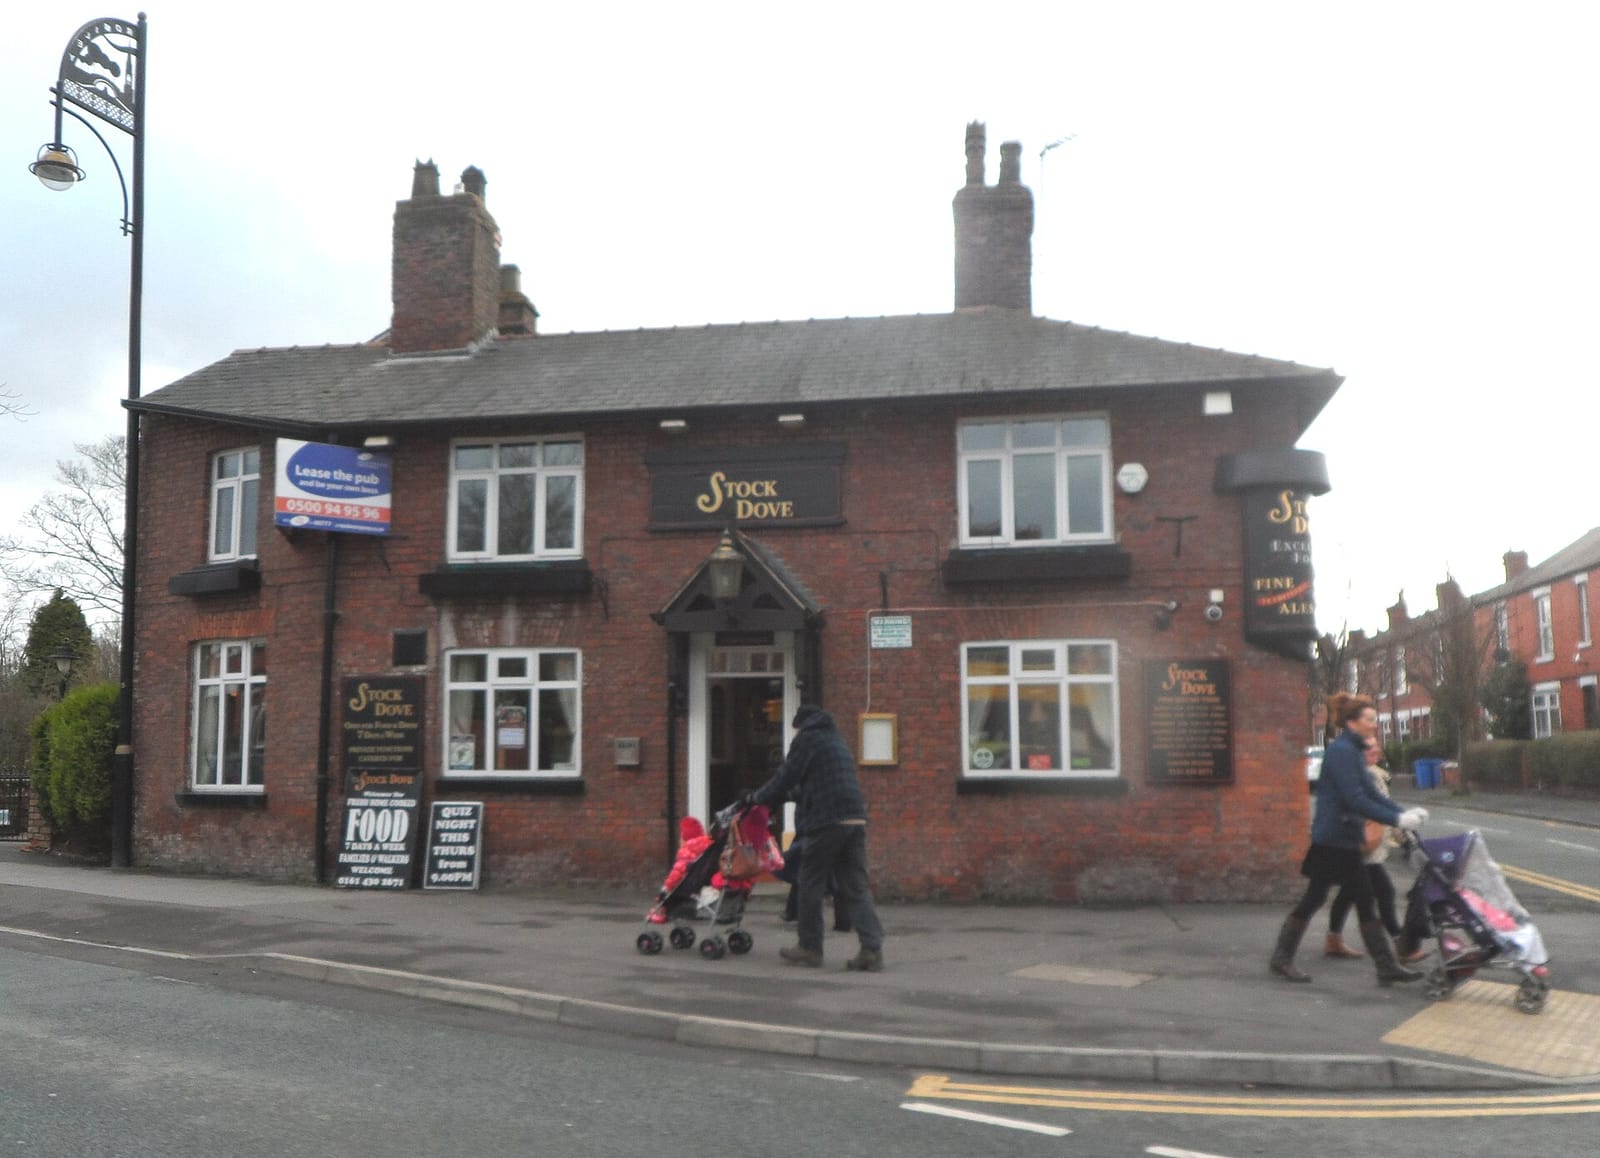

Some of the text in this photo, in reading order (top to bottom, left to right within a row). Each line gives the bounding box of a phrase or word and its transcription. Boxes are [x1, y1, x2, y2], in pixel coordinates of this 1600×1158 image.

[295, 464, 379, 485] Lease the pub
[697, 471, 778, 513] STOCK
[286, 499, 380, 520] 0500 94 95 96
[737, 499, 794, 519] DOVE
[1256, 577, 1294, 590] FINE
[1162, 663, 1207, 691] STOCK
[1181, 681, 1216, 695] DOVE
[349, 683, 403, 712] STOCK
[375, 702, 414, 716] DOVE
[354, 772, 413, 791] STOCK DOVE
[441, 807, 473, 818] QUIZ
[345, 808, 410, 842] FOOD
[436, 819, 476, 830] NIGHT
[440, 832, 470, 843] THIS
[345, 842, 351, 850] 7
[351, 842, 372, 850] DAYS
[382, 843, 406, 851] WEEK
[433, 846, 476, 856] THURS
[339, 853, 370, 863] FAMILIES
[438, 859, 467, 869] from
[351, 866, 393, 875] WELCOME
[338, 877, 360, 885] 0161
[431, 872, 473, 883] 9.00PM
